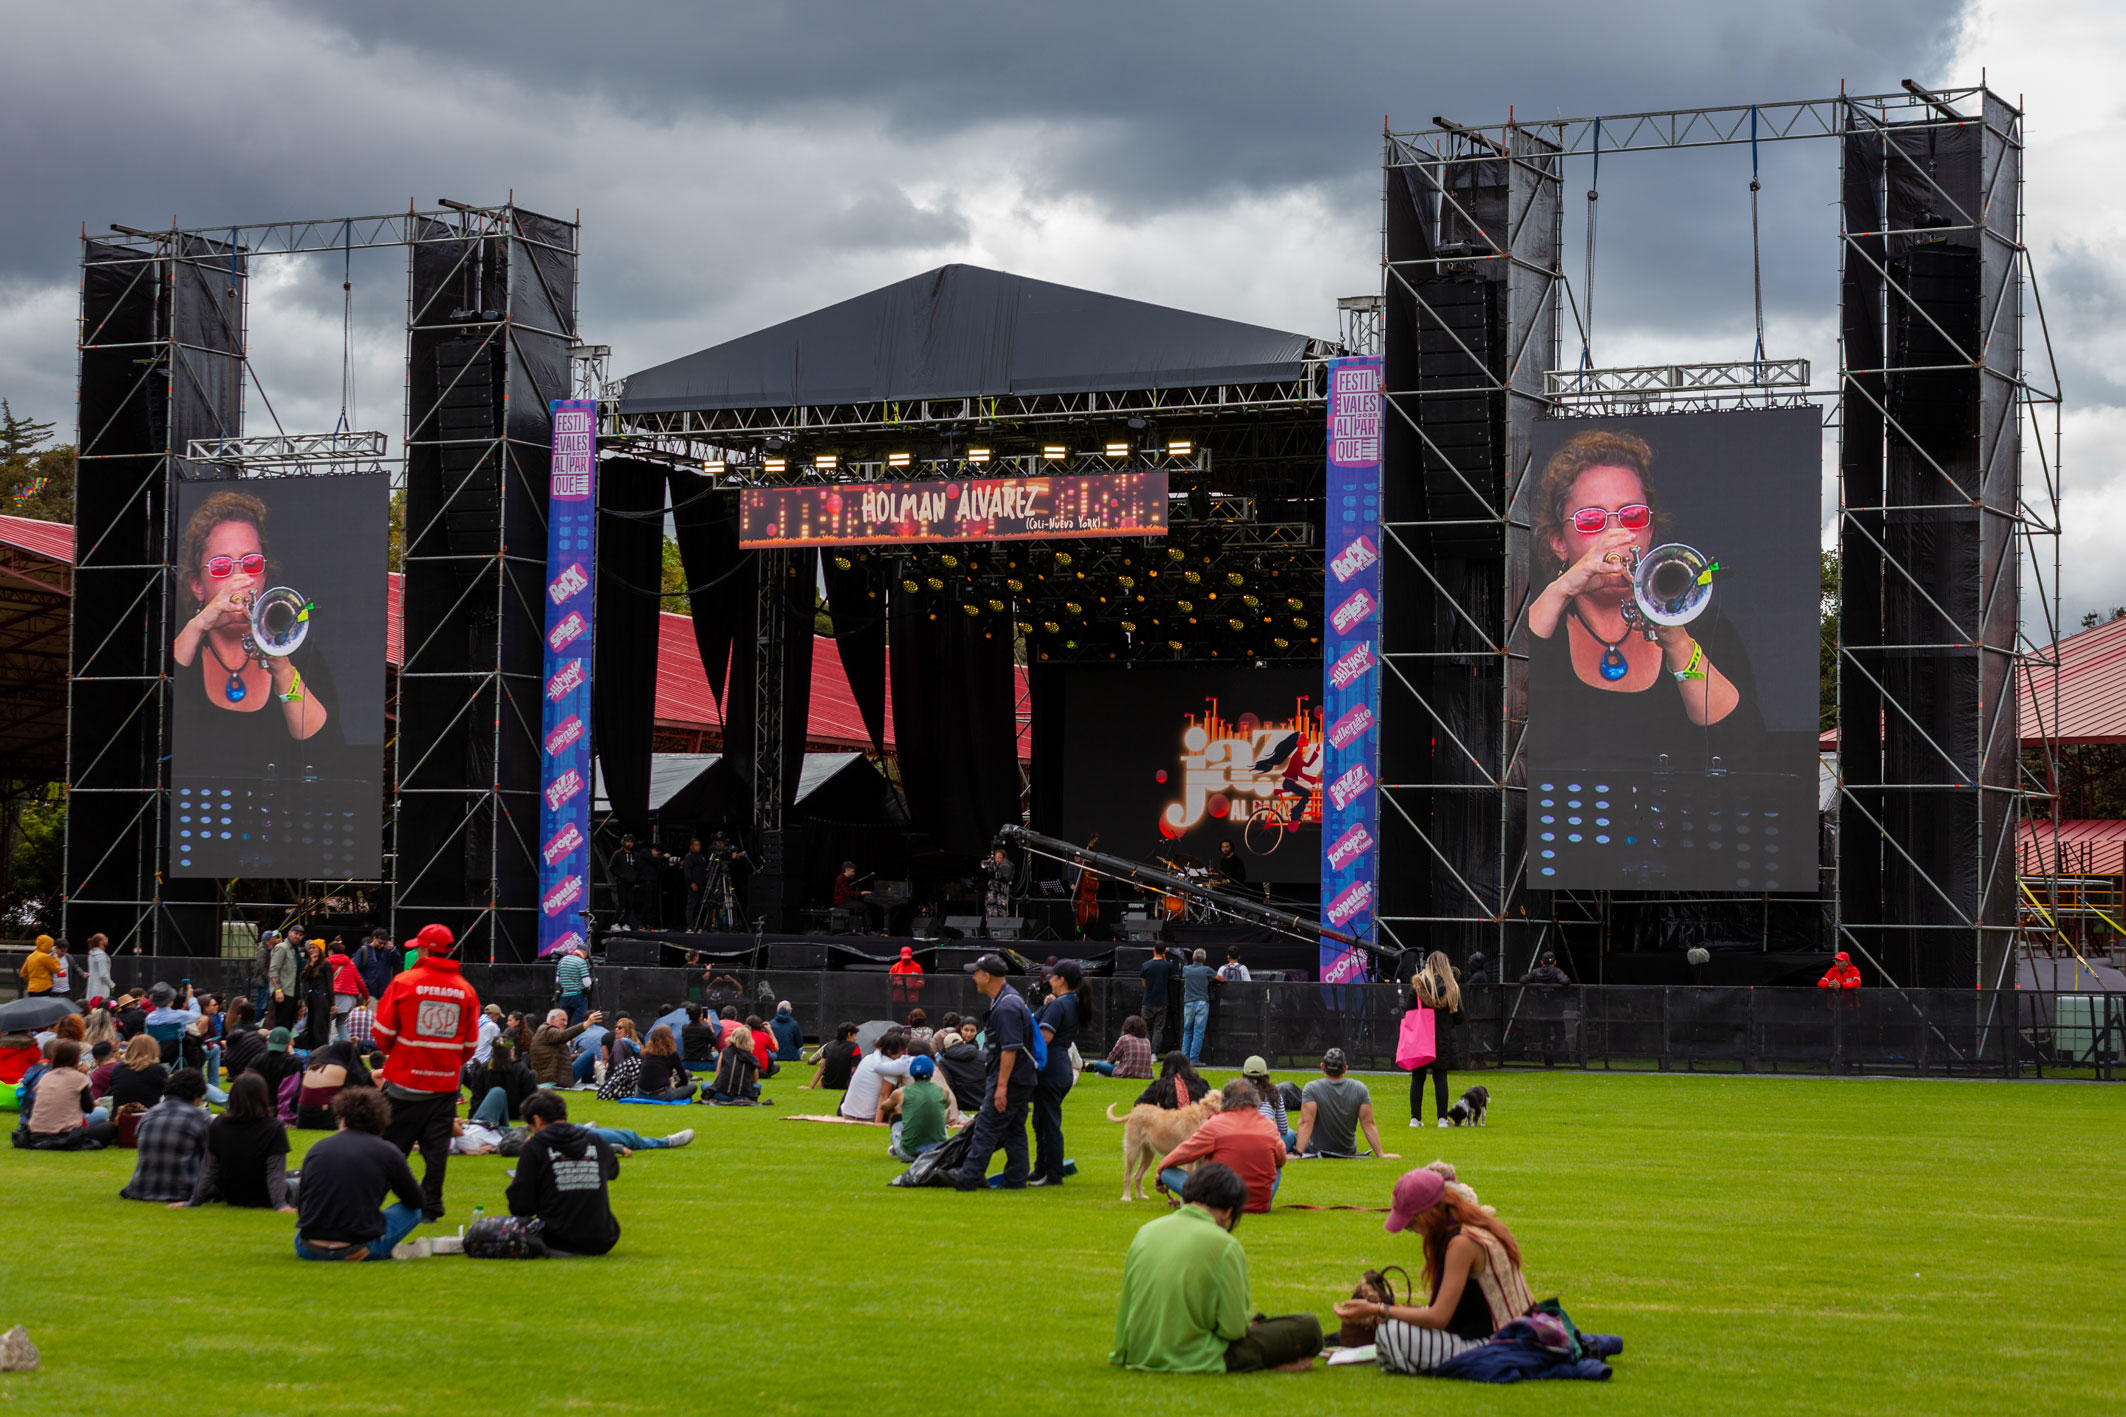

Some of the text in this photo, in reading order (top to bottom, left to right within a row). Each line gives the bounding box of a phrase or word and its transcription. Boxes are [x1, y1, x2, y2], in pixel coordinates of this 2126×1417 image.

[1339, 372, 1369, 391] FESTI
[1343, 394, 1377, 413] VALES
[557, 414, 582, 431] FESTI
[1336, 419, 1376, 436] AL PAR
[559, 434, 588, 452] VALES
[1338, 440, 1360, 459] QUE
[553, 456, 587, 472] AL PAR
[555, 476, 574, 493] QUE
[861, 482, 1039, 523] HOLMAN ÁLVAREZ
[1229, 799, 1250, 821] AL
[542, 828, 579, 865] Joropo
[1327, 829, 1367, 870] Joropo
[416, 984, 465, 1000] OPERADOR
